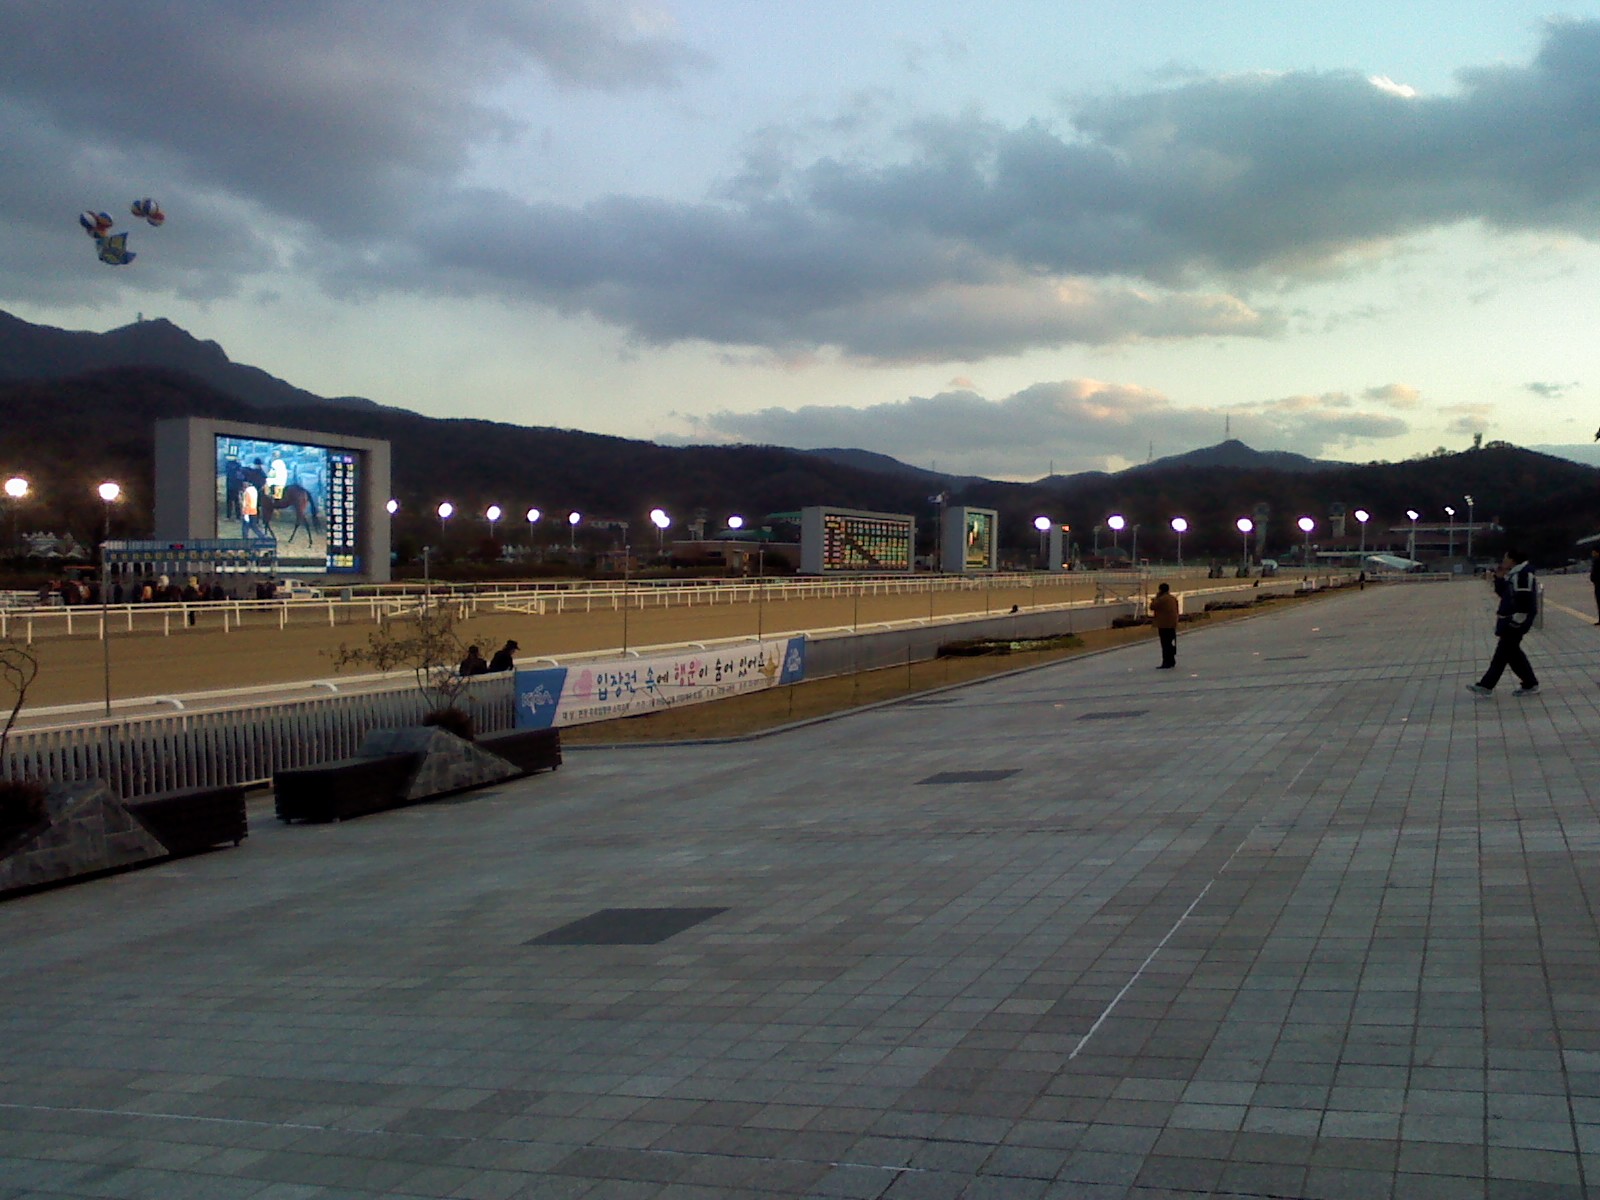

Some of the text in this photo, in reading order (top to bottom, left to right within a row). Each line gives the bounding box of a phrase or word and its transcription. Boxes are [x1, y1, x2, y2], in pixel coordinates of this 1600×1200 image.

[597, 670, 637, 701] 입장권
[645, 667, 669, 694] 속에
[674, 661, 708, 687] 행운이
[715, 658, 734, 682] 숨어
[738, 651, 765, 678] 있어요
